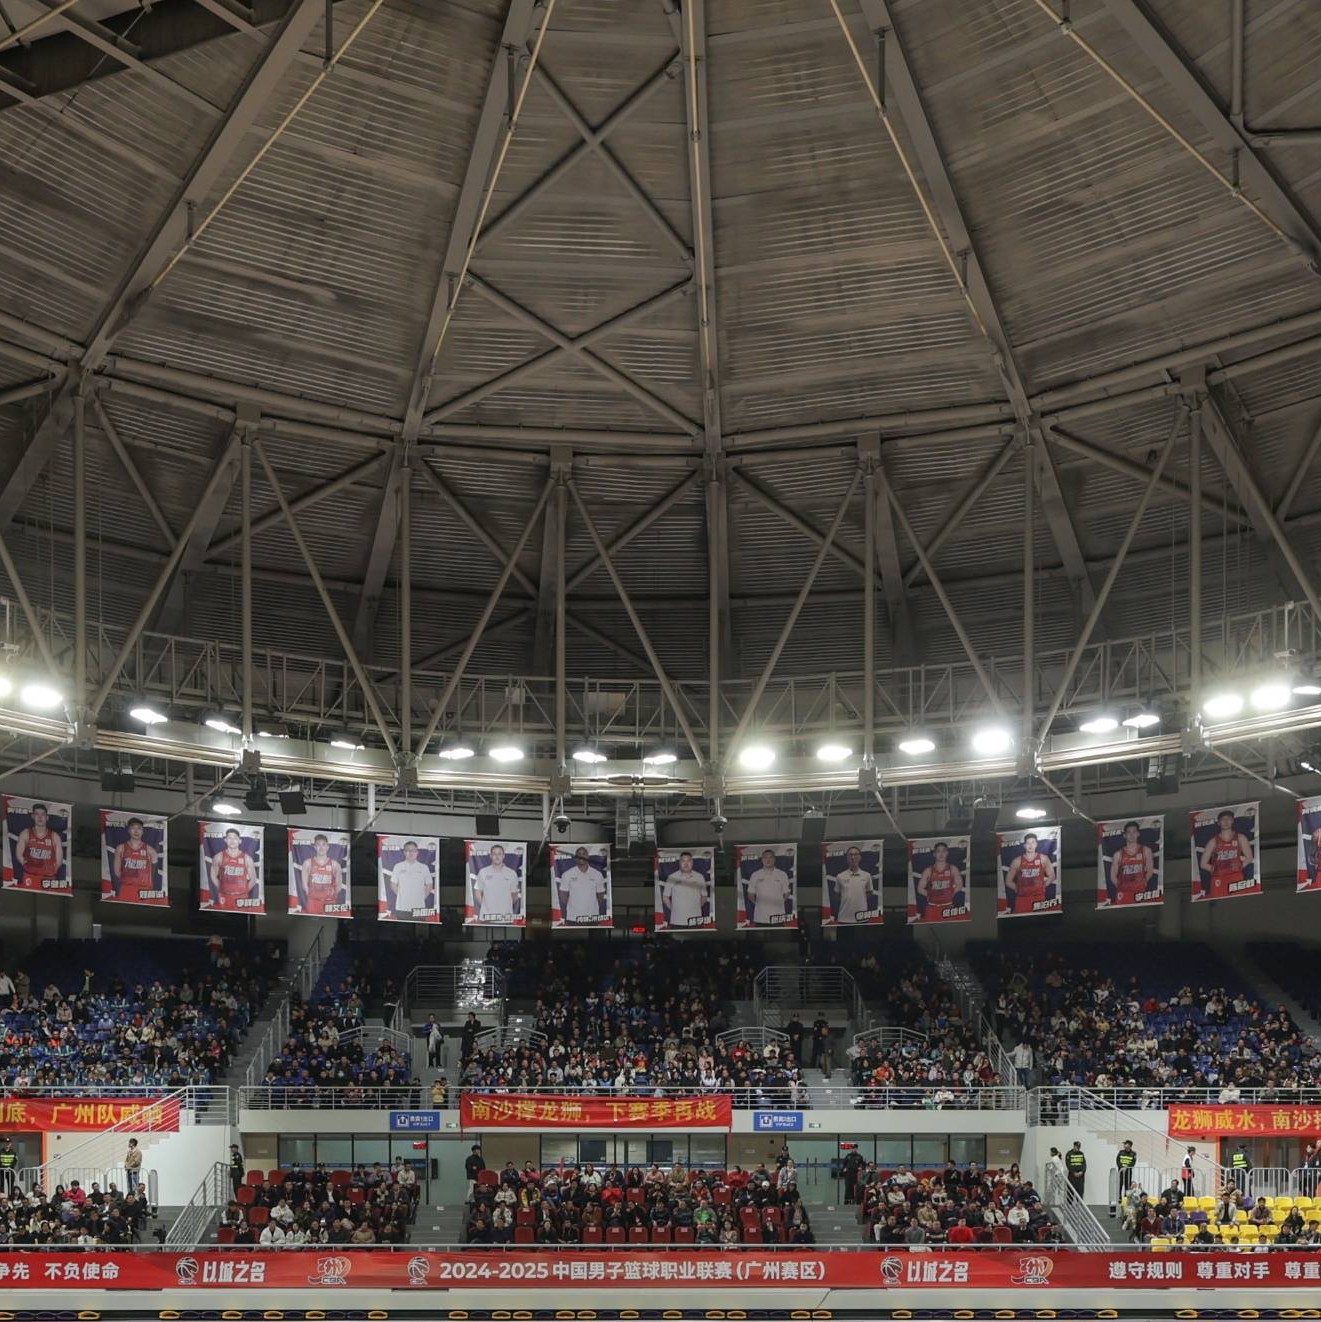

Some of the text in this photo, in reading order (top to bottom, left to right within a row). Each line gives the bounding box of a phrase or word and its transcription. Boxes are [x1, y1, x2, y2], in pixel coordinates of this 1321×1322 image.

[44, 1262, 120, 1282] 不负使命
[203, 1261, 266, 1282] 以城之名
[440, 1261, 549, 1280] 2024-2025
[908, 1261, 970, 1282] 以城之名
[1109, 1261, 1183, 1281] 遵守规则
[1197, 1261, 1271, 1281] 尊重对手
